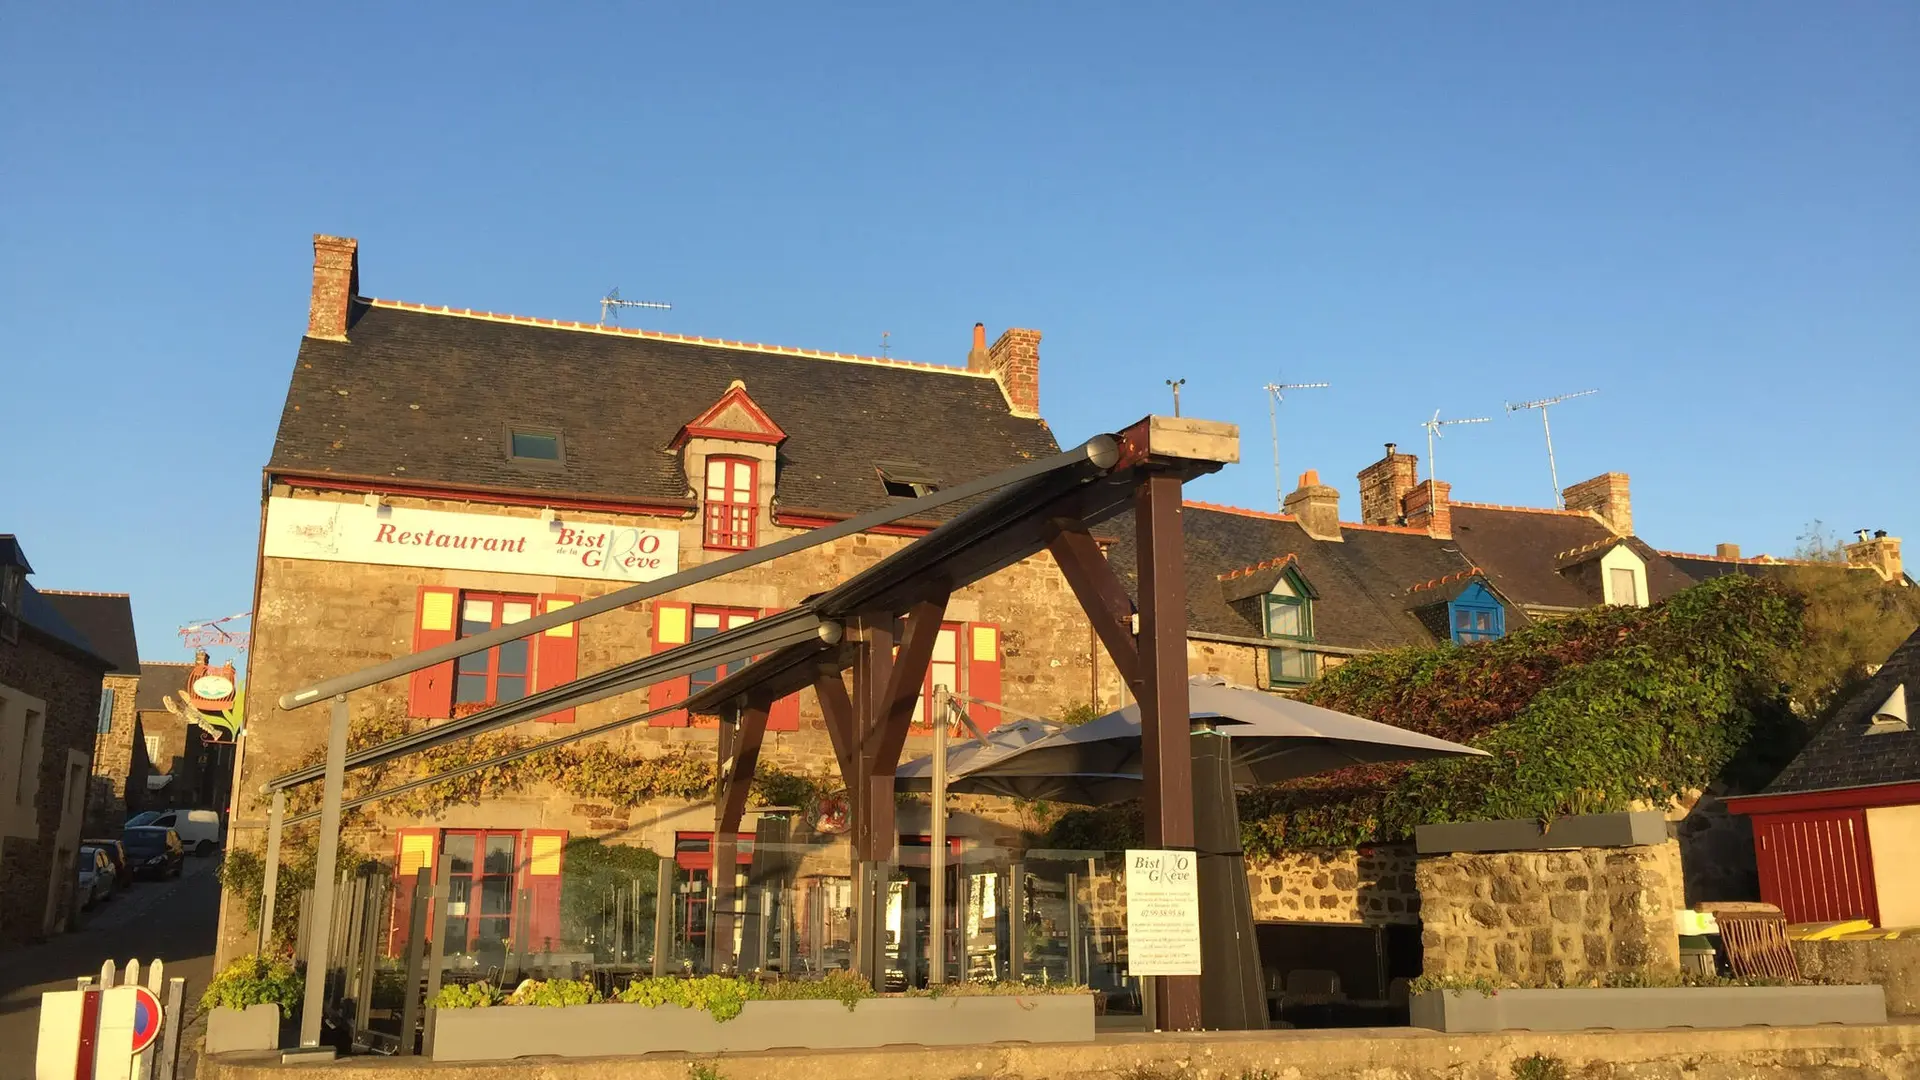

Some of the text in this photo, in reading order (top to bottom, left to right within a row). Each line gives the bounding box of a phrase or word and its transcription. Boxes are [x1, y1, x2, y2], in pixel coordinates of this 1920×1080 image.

[374, 523, 527, 553] Restaurant
[556, 547, 578, 556] de la
